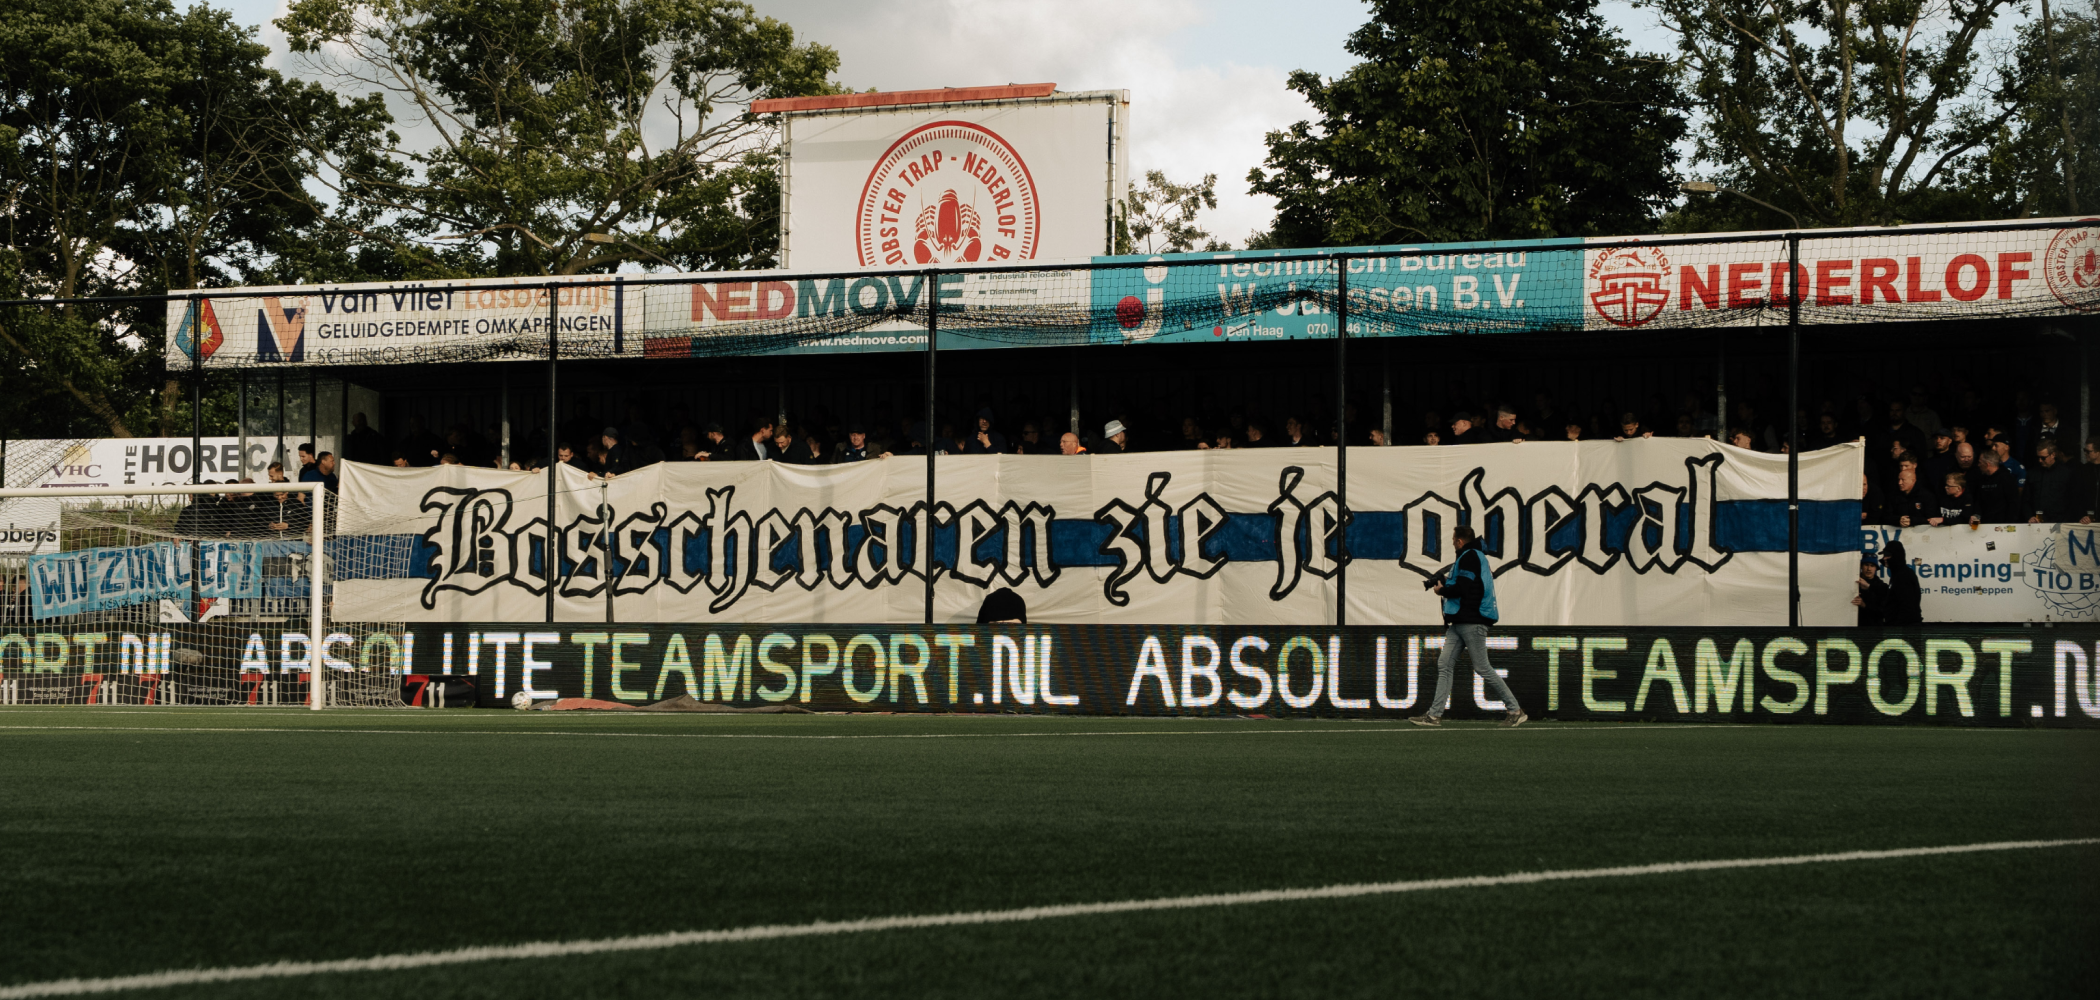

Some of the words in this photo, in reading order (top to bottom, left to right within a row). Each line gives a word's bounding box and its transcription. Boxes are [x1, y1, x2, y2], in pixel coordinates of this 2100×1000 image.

[880, 187, 908, 265] OBSTER
[898, 150, 943, 188] TRAP
[963, 151, 1017, 239] NEDERLOF
[989, 272, 1028, 281] Industrial
[1029, 270, 1072, 280] relocation
[1213, 250, 1387, 278] Technisch
[1400, 248, 1527, 271] Bureau
[1651, 248, 1673, 277] FISH
[2056, 247, 2071, 303] LOBSTER
[2066, 230, 2088, 263] TRAP
[320, 287, 378, 314] Van
[389, 282, 455, 312] Vliet
[465, 277, 612, 314] Lasbedrijf
[989, 287, 1038, 297] Dismantling
[1218, 282, 1262, 317] W.
[1276, 281, 1439, 317] Janssen
[1453, 273, 1525, 311] B.V.
[1679, 251, 2033, 312] NEDERLOF
[690, 274, 965, 323] NEDMOVE
[318, 320, 470, 339] GELUIDGEDEMPTE
[475, 315, 612, 335] OMKAPPNGEN
[798, 334, 929, 348] www.nedmove.com
[1227, 325, 1250, 337] Den
[1253, 324, 1284, 338] Haag
[1307, 323, 1329, 335] 070
[1365, 323, 1378, 334] 12
[539, 340, 613, 360] 633036
[50, 464, 102, 478] VHC
[141, 444, 292, 474] HORECA
[123, 445, 137, 510] EHTE
[420, 485, 1062, 614] Bosschenaren
[1094, 471, 1231, 607] zie
[1268, 465, 1353, 601] je
[1399, 452, 1734, 577] overal
[37, 554, 90, 606] WIJ
[173, 541, 254, 592] LEF!
[1880, 559, 2012, 583] demping
[2033, 569, 2073, 591] TIO
[2080, 573, 2100, 592] B.
[1941, 586, 2013, 596] Regeneppen
[571, 632, 1080, 706] TEAMSPORT.NL
